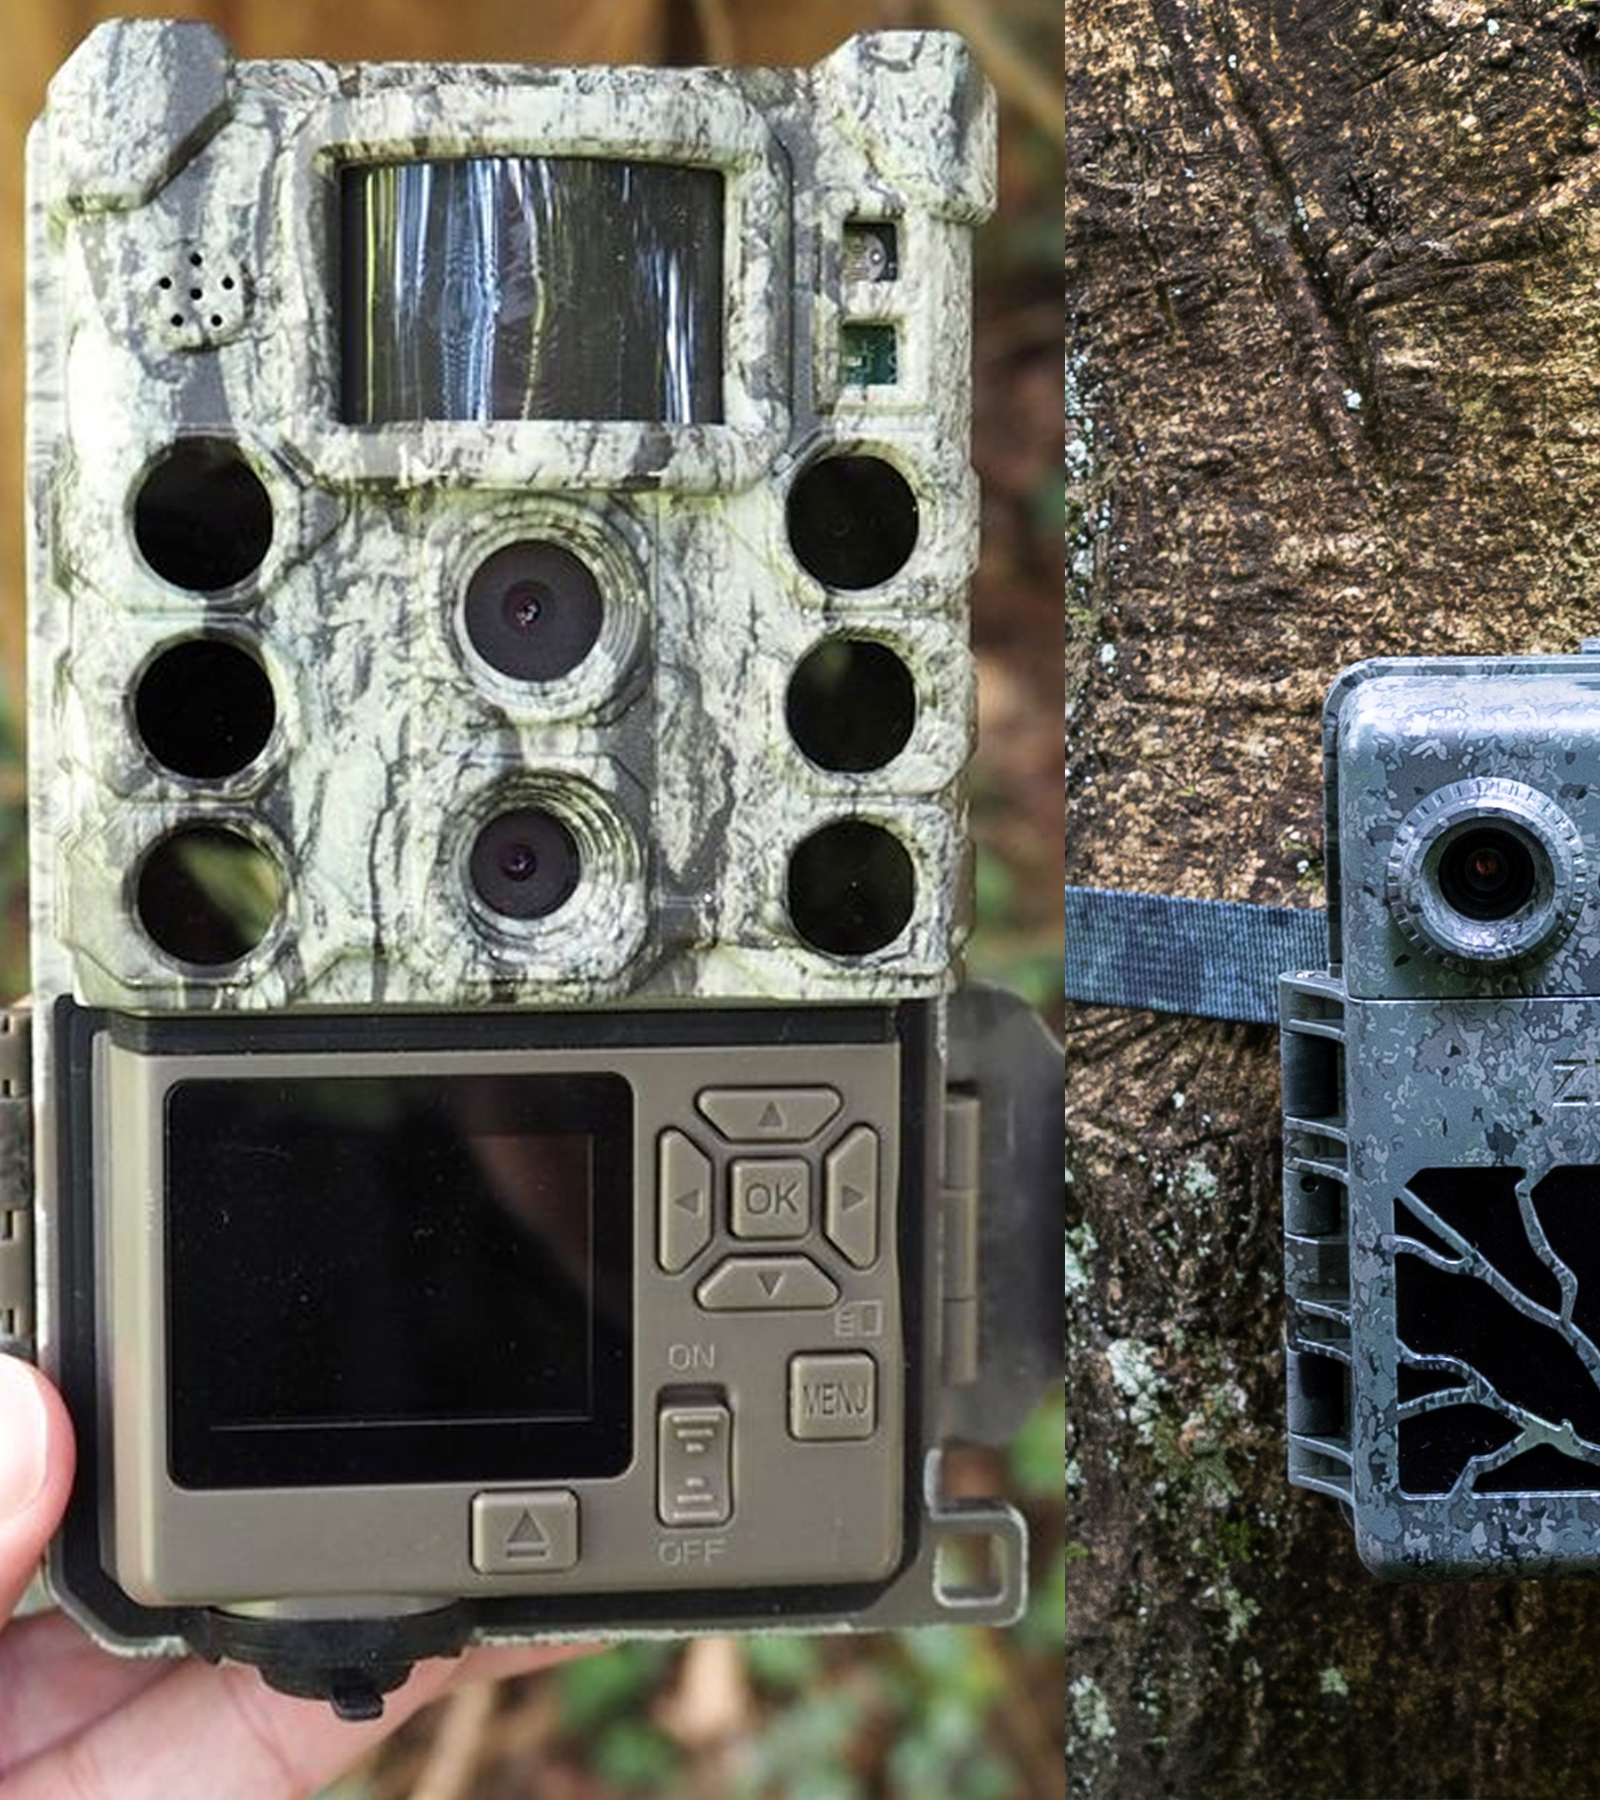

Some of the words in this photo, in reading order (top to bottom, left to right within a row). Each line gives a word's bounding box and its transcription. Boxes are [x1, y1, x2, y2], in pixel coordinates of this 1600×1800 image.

[744, 1181, 800, 1215] OK
[667, 1343, 716, 1369] ON
[801, 1383, 868, 1416] MENU
[657, 1538, 727, 1567] OFF
